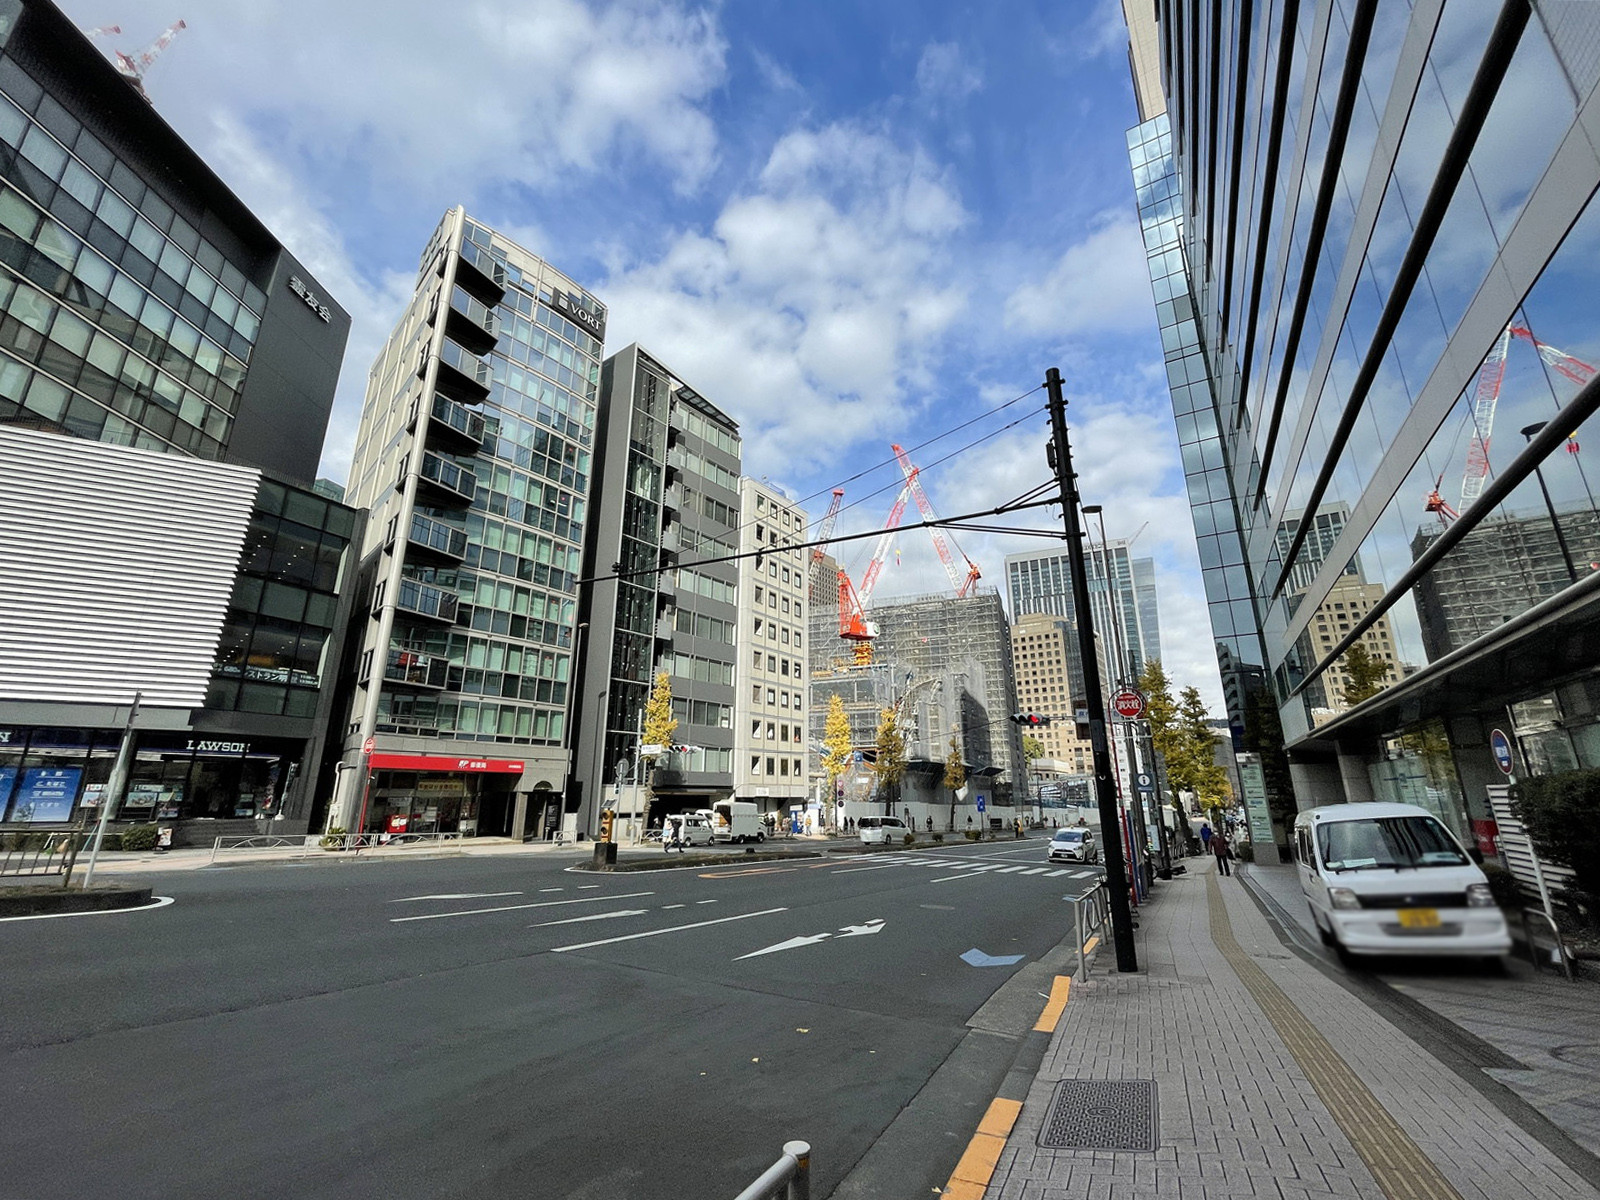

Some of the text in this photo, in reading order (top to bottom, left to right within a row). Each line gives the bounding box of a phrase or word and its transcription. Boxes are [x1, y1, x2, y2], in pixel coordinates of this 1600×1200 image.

[571, 302, 602, 330] VORT
[1117, 699, 1140, 710] 消火栓
[186, 740, 251, 753] LAWSON
